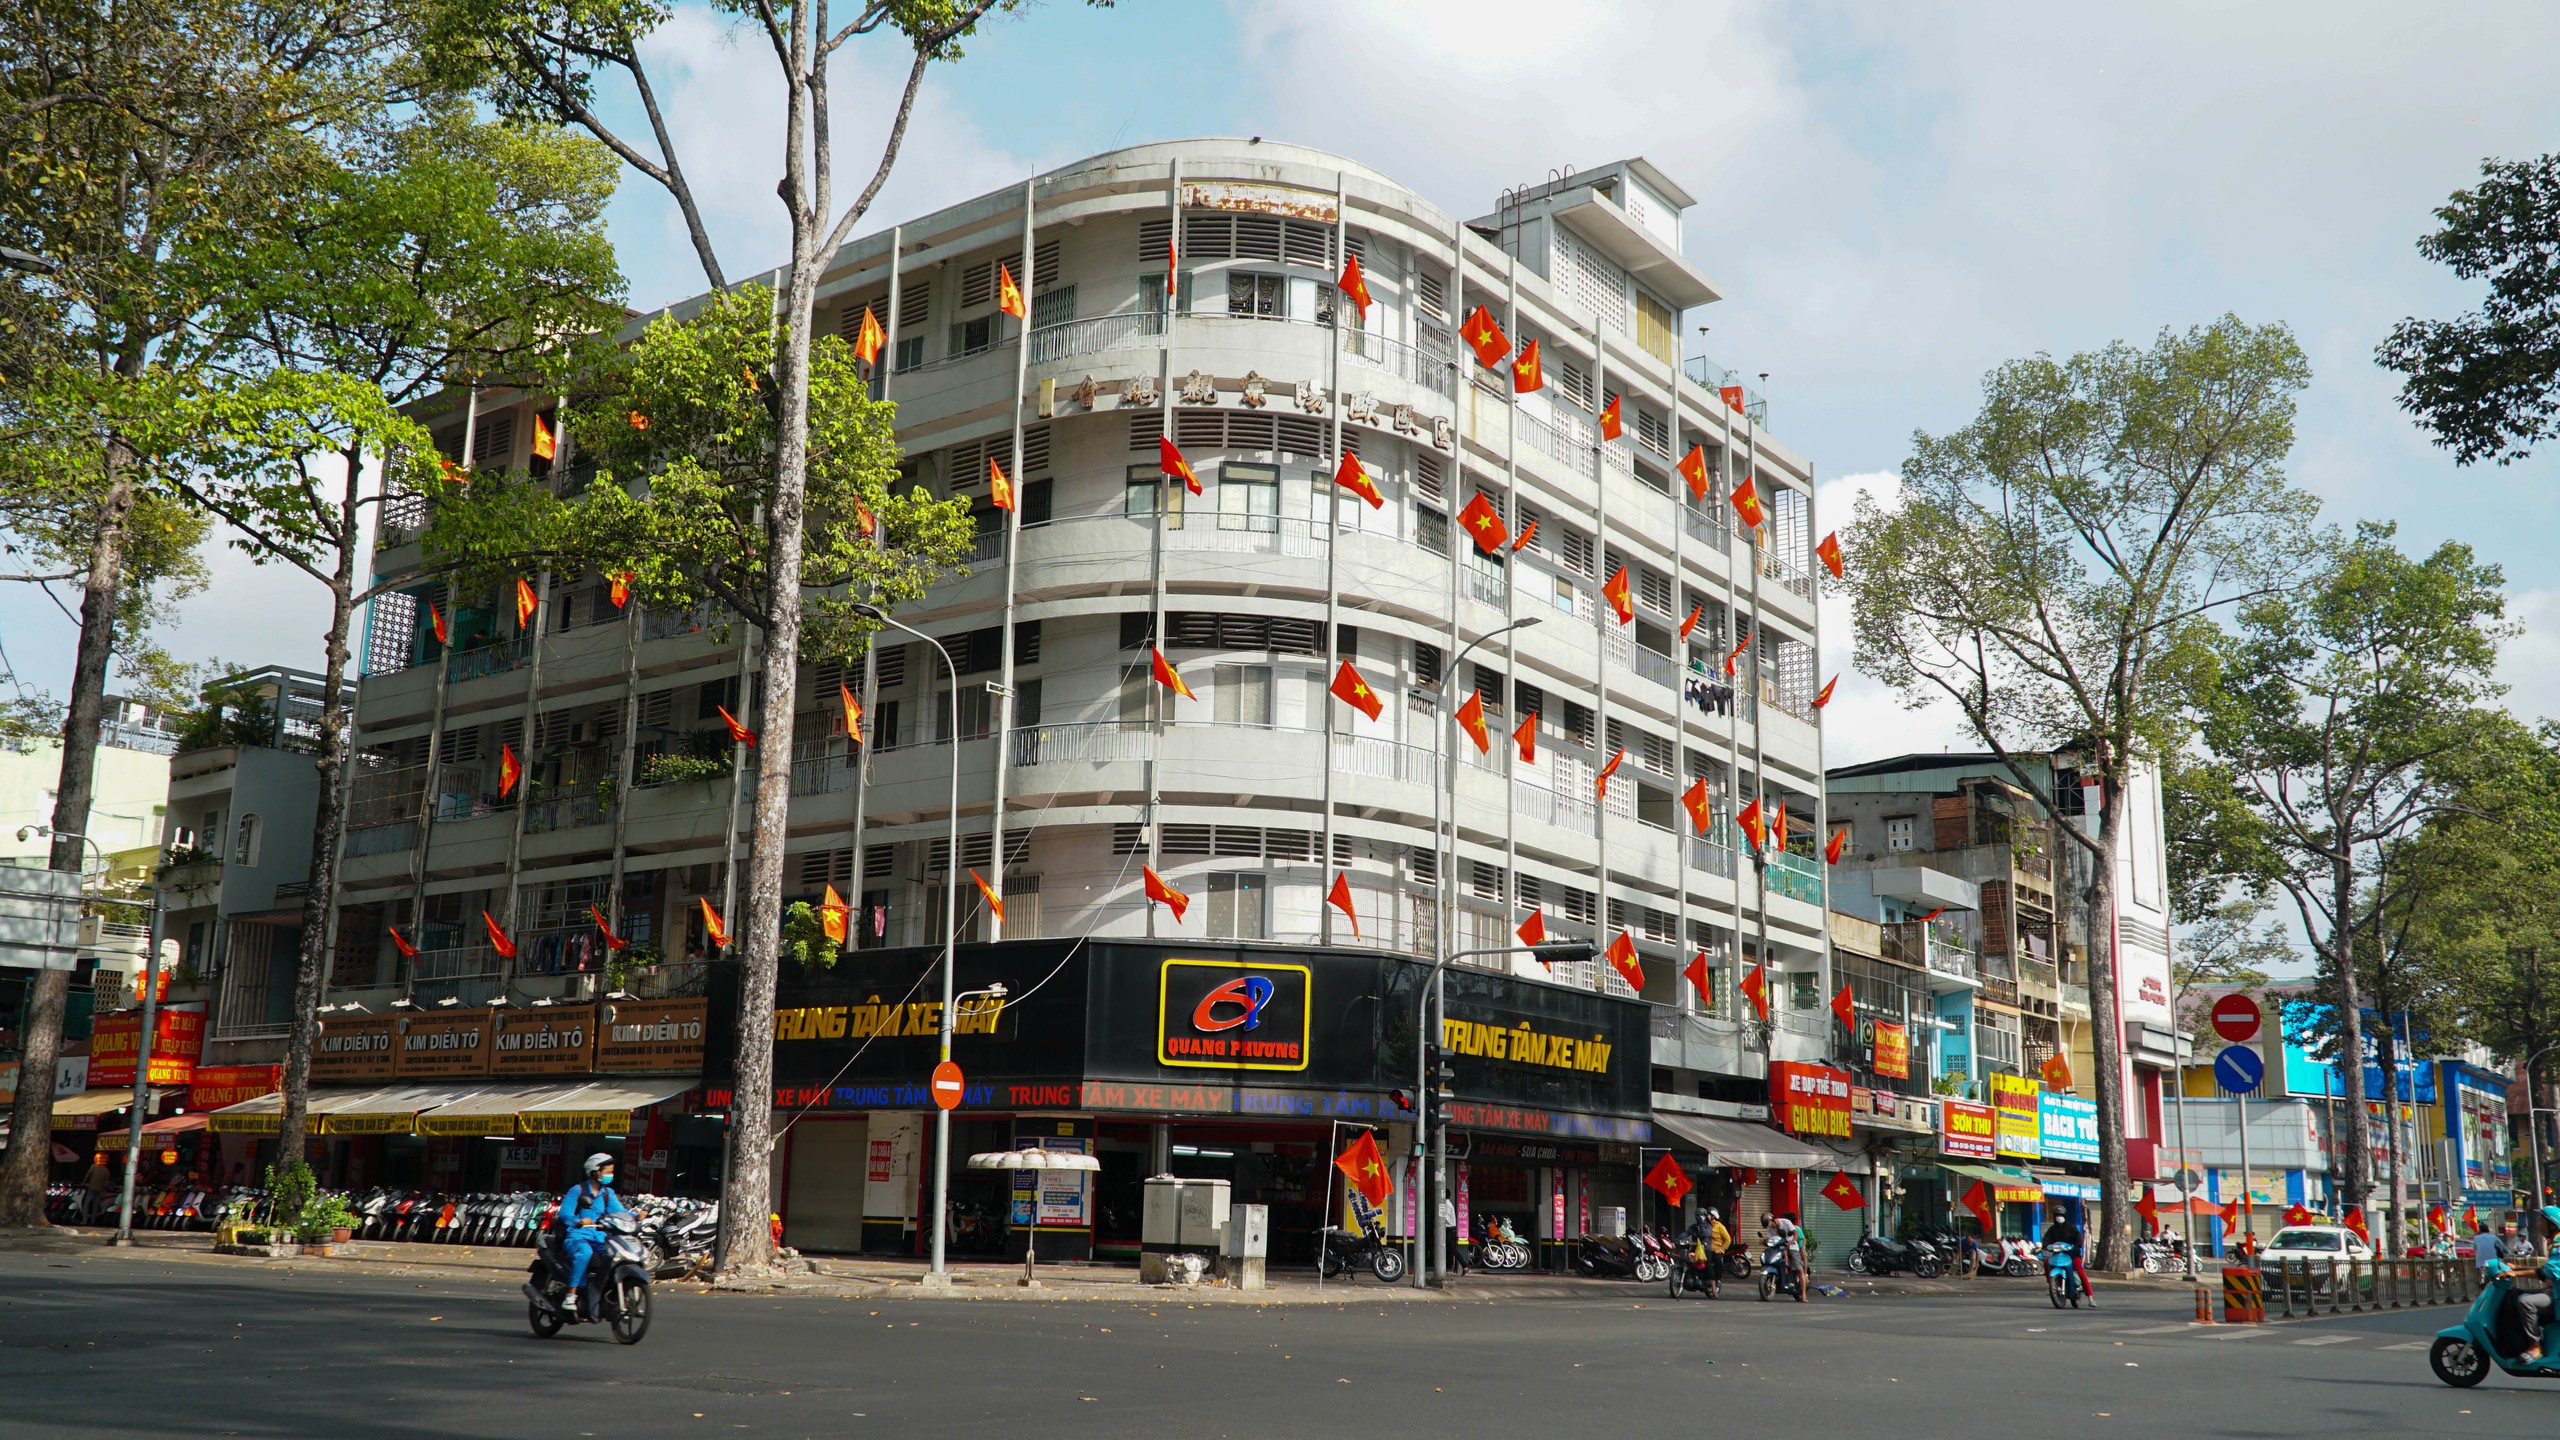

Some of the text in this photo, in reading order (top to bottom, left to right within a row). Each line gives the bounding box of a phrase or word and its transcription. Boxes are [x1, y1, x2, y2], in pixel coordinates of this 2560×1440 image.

[170, 1014, 197, 1031] XE MÁY
[774, 1006, 848, 1040] TRUNG
[850, 994, 904, 1038] TÂM
[901, 1002, 943, 1036] XE
[496, 1033, 521, 1050] KIM
[562, 1025, 583, 1048] TÔ
[612, 1024, 641, 1042] KIM
[681, 1016, 701, 1040] TÔ
[92, 1032, 128, 1057] QUANG
[320, 1036, 342, 1052] KIM
[373, 1030, 389, 1050] TÔ
[405, 1034, 426, 1050] KIM
[1168, 1038, 1226, 1057] QUANG
[1443, 1018, 1612, 1073] TRUNG TÂM XE MÁY
[150, 1068, 172, 1081] QUANG
[174, 1069, 190, 1080] VINH
[1790, 1074, 1800, 1092] XE
[1802, 1076, 1816, 1097] ĐẠP
[1816, 1072, 1830, 1095] THỂ
[1831, 1080, 1848, 1098] THAO
[192, 1088, 233, 1105] QUANG
[776, 1088, 794, 1106] XE
[798, 1082, 832, 1106] MÁY
[893, 1084, 928, 1105] TÂM
[1009, 1080, 1223, 1110] TRUNG TÂM XE MÁY
[1320, 1089, 1370, 1116] TÂM
[585, 1116, 592, 1130] XE
[1478, 1102, 1504, 1127] TÂM
[1507, 1110, 1521, 1130] XE
[1524, 1108, 1549, 1132] MÁY
[1793, 1104, 1809, 1132] GIA
[1810, 1098, 1828, 1135] BẢO
[1830, 1110, 1850, 1137] BIKE
[1973, 1117, 1992, 1136] THU
[2043, 1108, 2076, 1139] BÁCH
[506, 1147, 537, 1161] XE 50
[2009, 1190, 2018, 1200] XE
[1458, 1203, 1468, 1211] TRẢ
[1458, 1211, 1468, 1219] GÓP
[1555, 1206, 1564, 1214] TRẢ
[1555, 1214, 1564, 1222] GÓP
